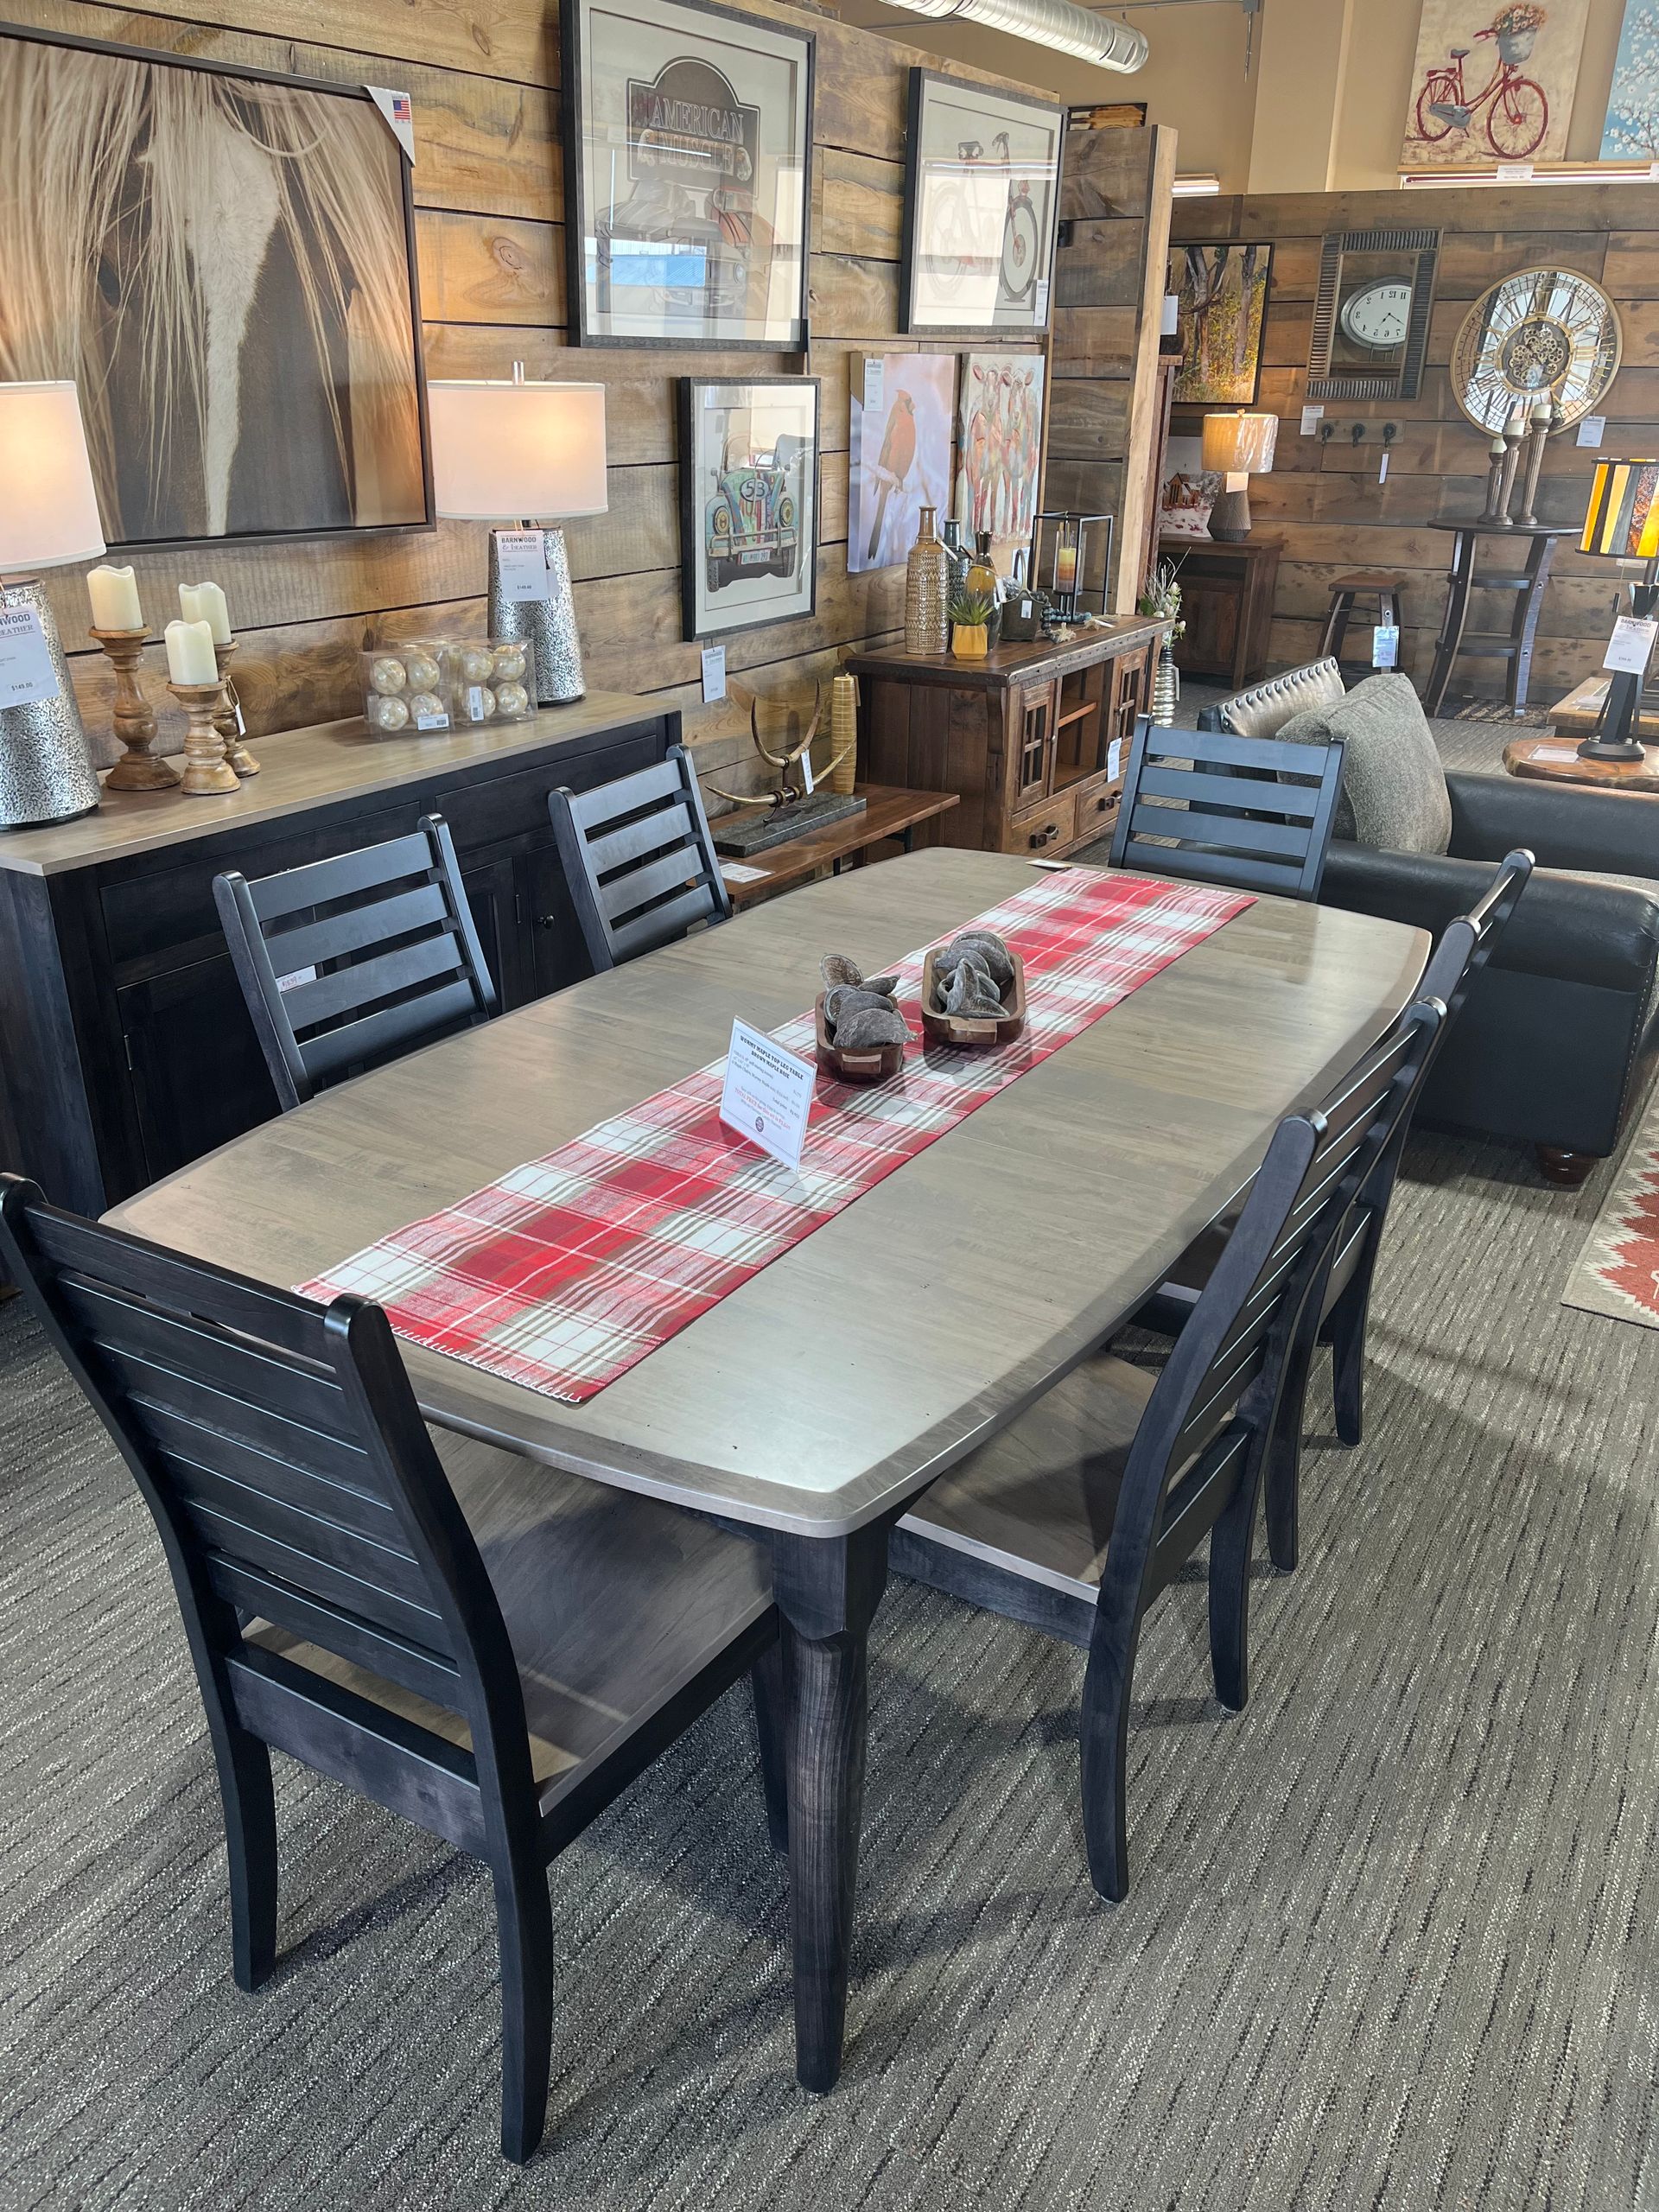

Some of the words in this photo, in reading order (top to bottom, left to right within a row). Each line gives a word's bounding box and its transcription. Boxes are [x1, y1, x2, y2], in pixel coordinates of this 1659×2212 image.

[650, 96, 744, 145] AMERICAN
[746, 480, 766, 498] 53
[11, 682, 34, 691] $149.00
[740, 1035, 757, 1049] WORMY
[756, 1046, 771, 1059] MAPLE
[771, 1055, 780, 1065] TOP
[780, 1061, 790, 1071] LEG
[789, 1067, 804, 1080] TABLE
[751, 1051, 766, 1064] BROWN
[766, 1059, 779, 1072] MAPLE
